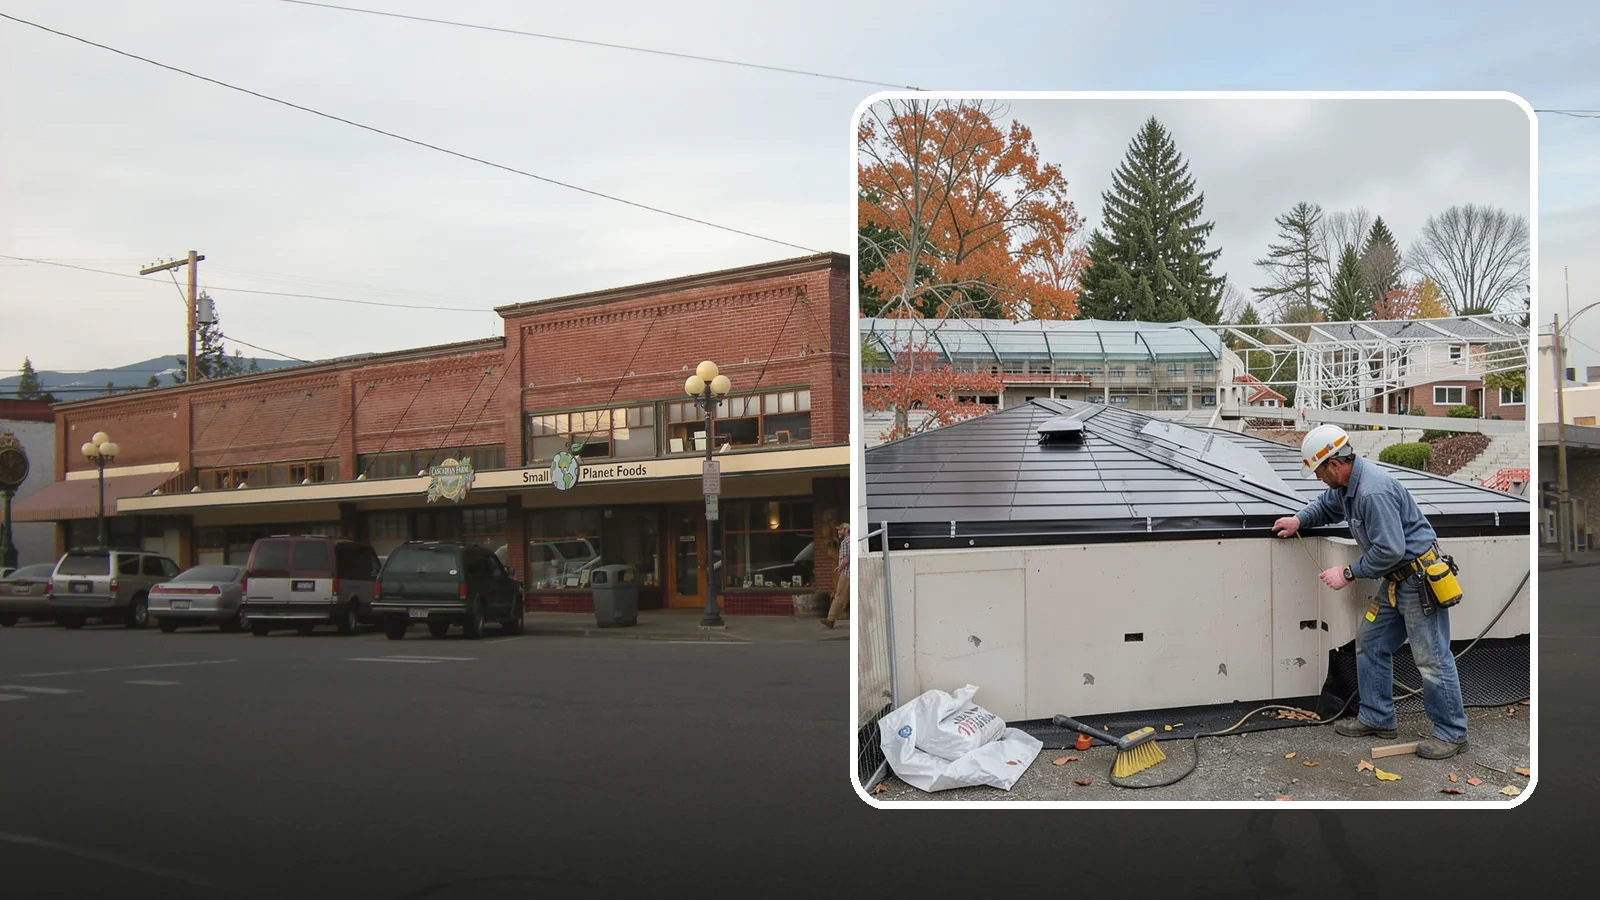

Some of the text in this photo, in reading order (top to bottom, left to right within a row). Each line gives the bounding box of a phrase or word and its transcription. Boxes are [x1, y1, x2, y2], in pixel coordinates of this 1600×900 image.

[523, 464, 647, 482] Small Planet Foods
